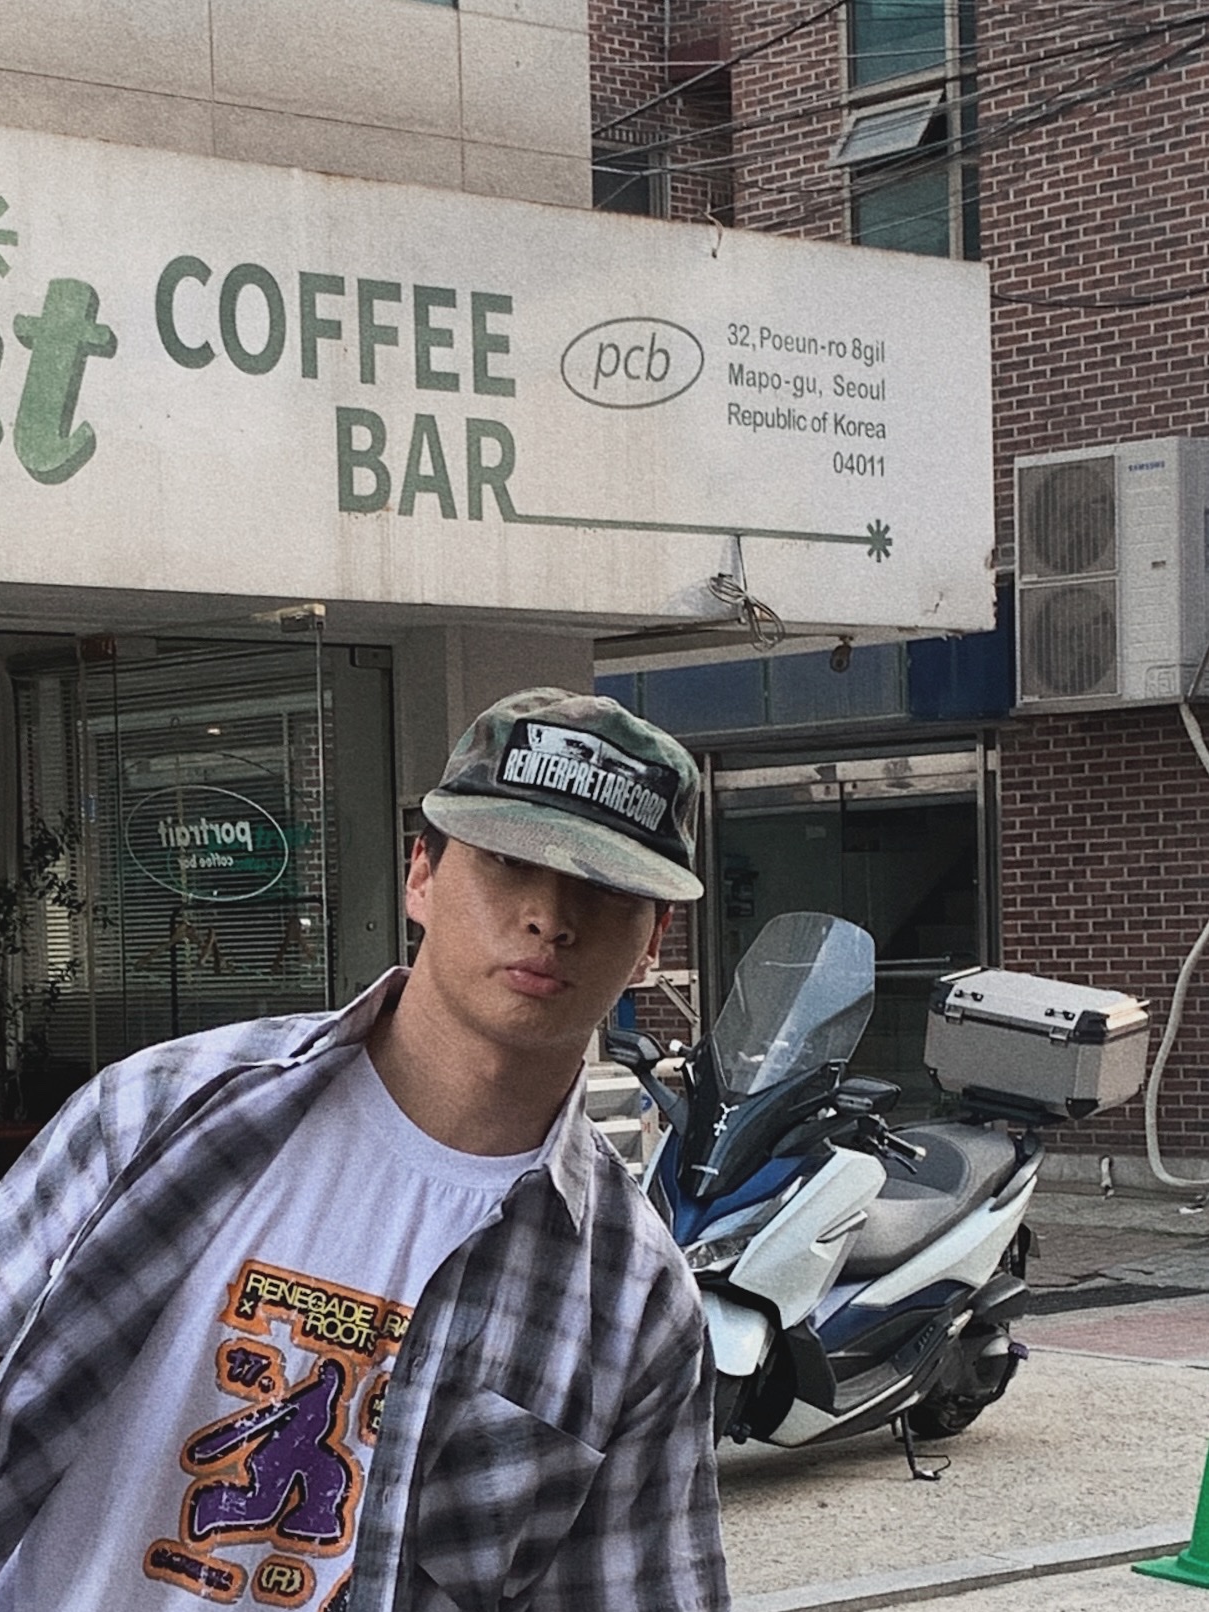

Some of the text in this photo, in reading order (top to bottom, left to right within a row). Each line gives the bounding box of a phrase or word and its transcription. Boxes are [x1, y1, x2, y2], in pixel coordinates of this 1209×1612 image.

[155, 255, 517, 397] COFFEE
[594, 332, 670, 389] pcb
[852, 338, 885, 366] 8gil
[728, 363, 886, 401] Mapo-gu, Seoul
[727, 403, 886, 439] Republic of Korea
[336, 406, 518, 520] BAR
[833, 452, 885, 477] 04011
[245, 1272, 375, 1329] RENEGADE
[305, 1311, 381, 1351] ROOTS
